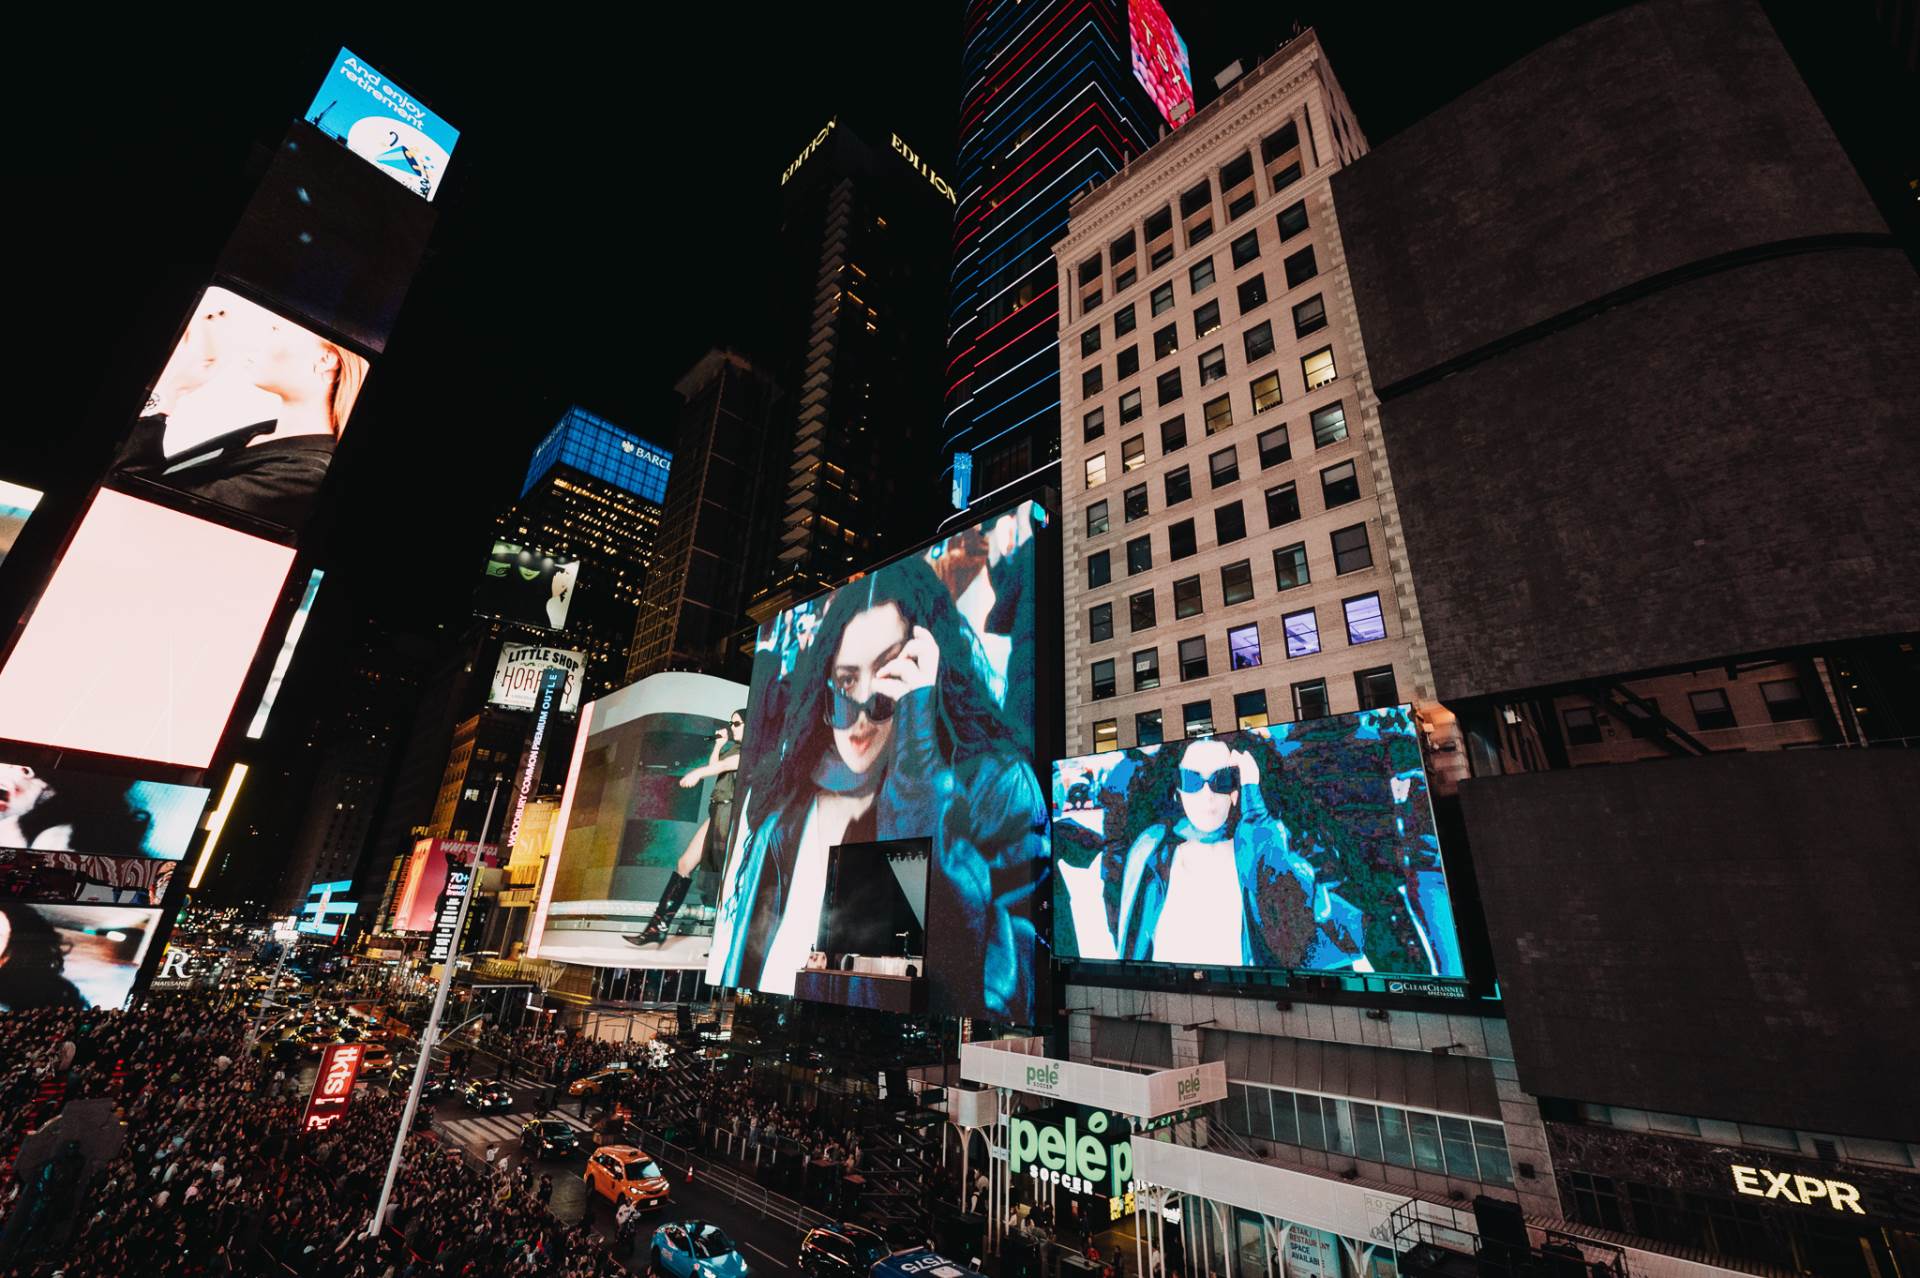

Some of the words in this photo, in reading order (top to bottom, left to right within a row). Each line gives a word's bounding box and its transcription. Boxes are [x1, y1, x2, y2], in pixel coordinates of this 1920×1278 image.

[340, 66, 424, 130] retirement
[344, 57, 382, 86] And
[382, 84, 426, 118] enjoy
[507, 649, 551, 664] LITTLE
[551, 652, 580, 672] SHOP
[506, 794, 528, 847] WOODBURY
[521, 750, 539, 795] COMMON
[532, 711, 549, 752] PREMIUM
[450, 872, 470, 883] 70+
[157, 951, 193, 978] R
[324, 1047, 358, 1095] tkts
[1029, 1164, 1093, 1195] SOCCER
[1290, 1242, 1311, 1254] SPACE
